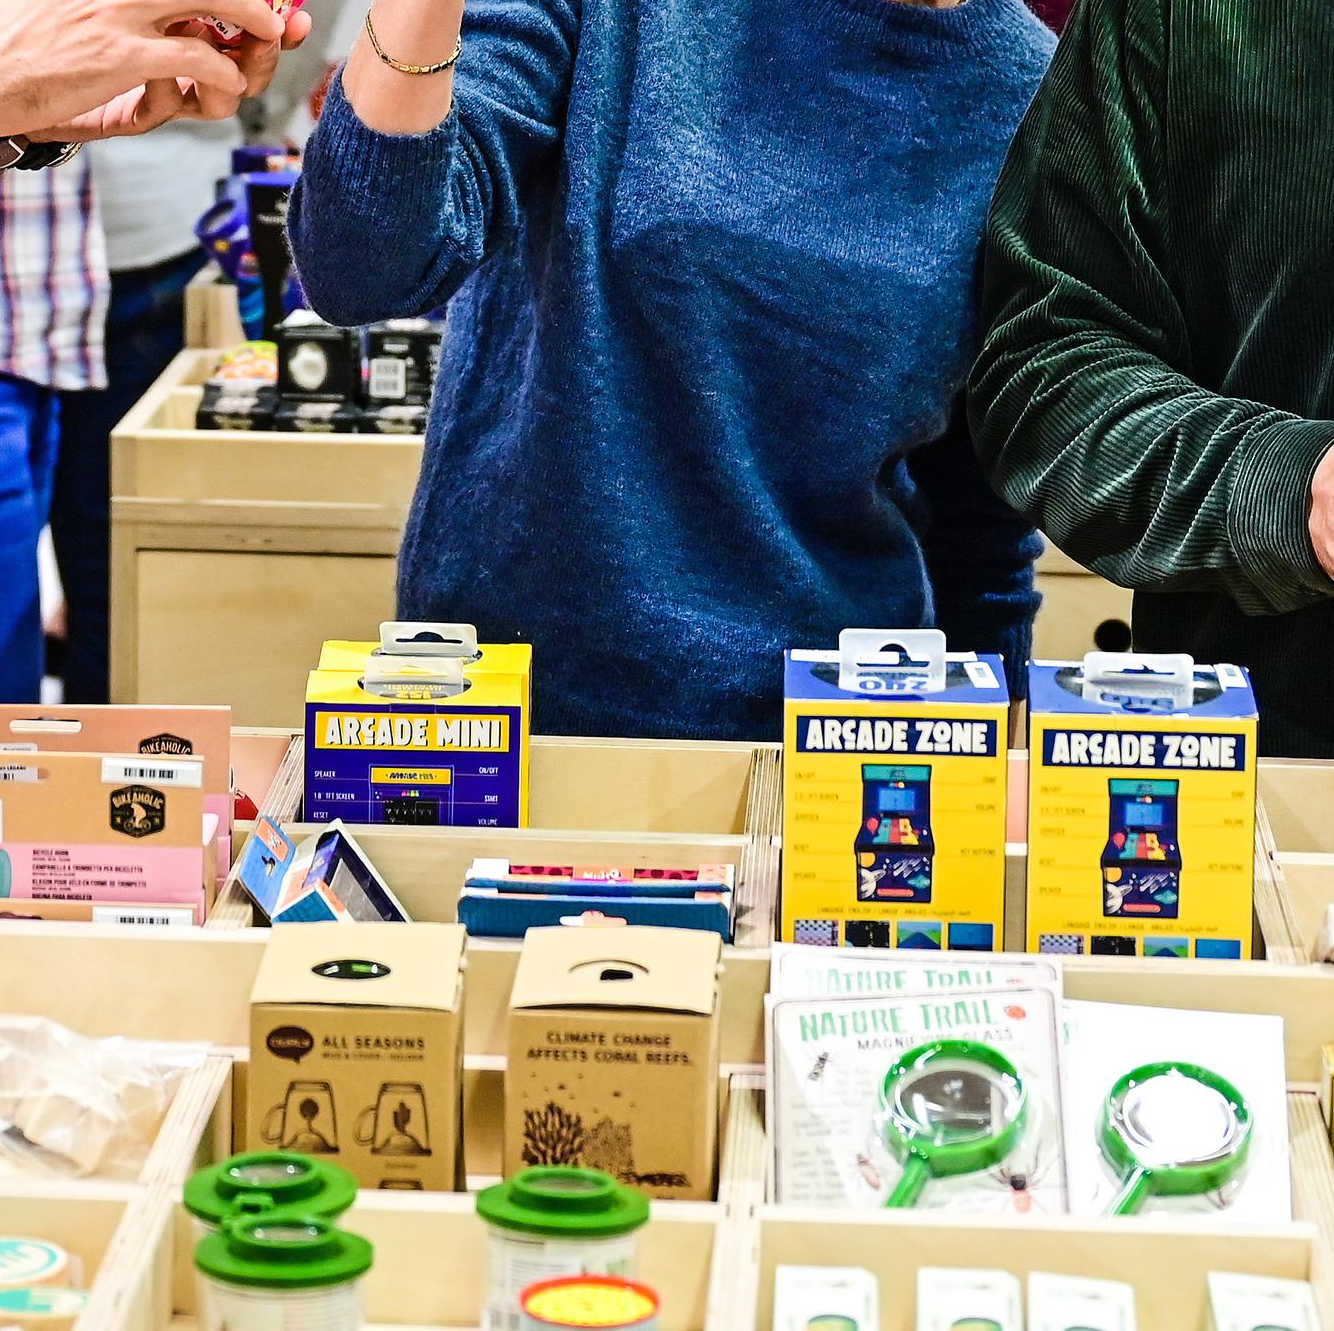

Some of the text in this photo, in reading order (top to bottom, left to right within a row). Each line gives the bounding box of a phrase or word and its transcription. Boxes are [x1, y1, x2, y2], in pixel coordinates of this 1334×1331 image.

[325, 716, 502, 749] ARCADE MINI
[805, 719, 988, 754] ARCADE ZONE
[140, 740, 192, 754] BIKEAHOLIC
[1052, 732, 1236, 768] ARCADE ZONE
[111, 790, 165, 810] BIKEAHOLIC
[798, 999, 999, 1042] NATURE TRAIL
[322, 1036, 348, 1049] ALL
[354, 1036, 426, 1050] SEASONS
[546, 1031, 672, 1047] CLIMATE CHANGE
[526, 1048, 588, 1062] AFFECTS
[594, 1050, 639, 1064] CORAL
